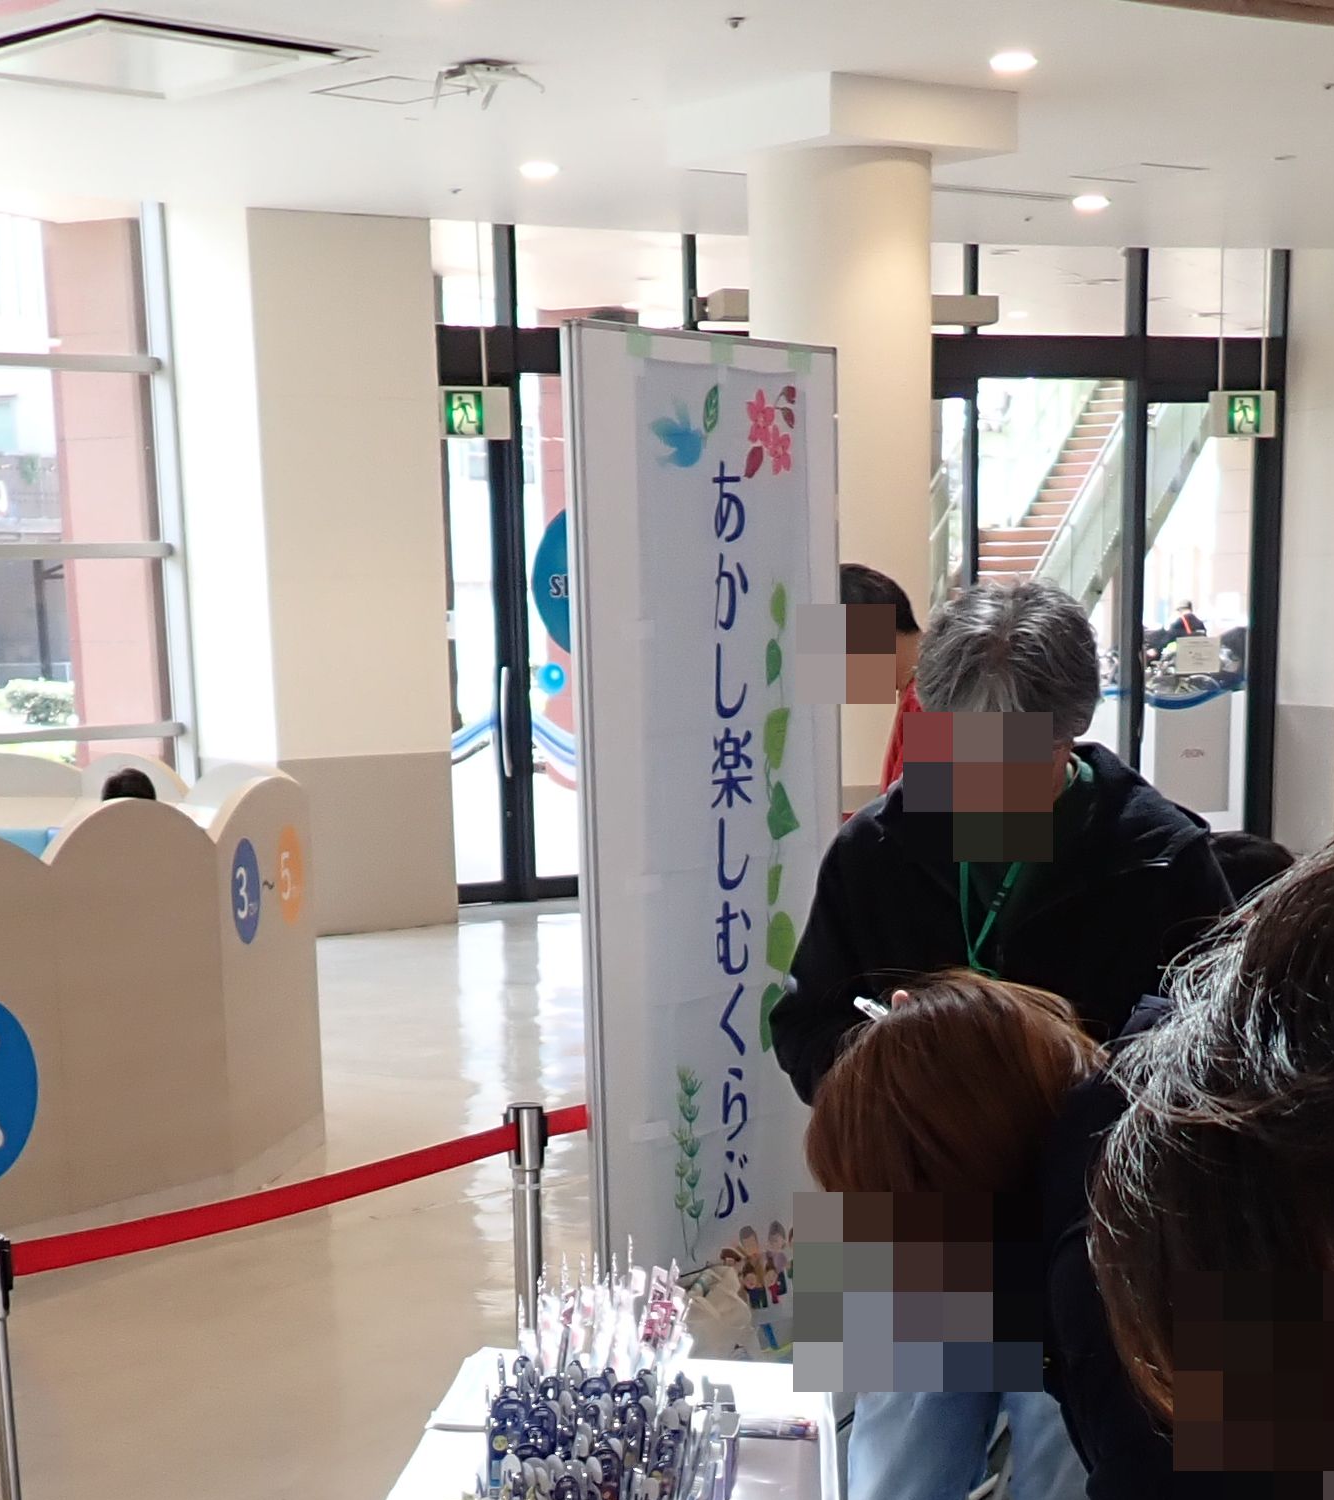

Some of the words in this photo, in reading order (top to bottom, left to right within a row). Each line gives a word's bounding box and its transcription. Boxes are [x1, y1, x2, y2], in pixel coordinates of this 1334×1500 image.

[711, 461, 755, 1219] あかし楽しむくらぶ
